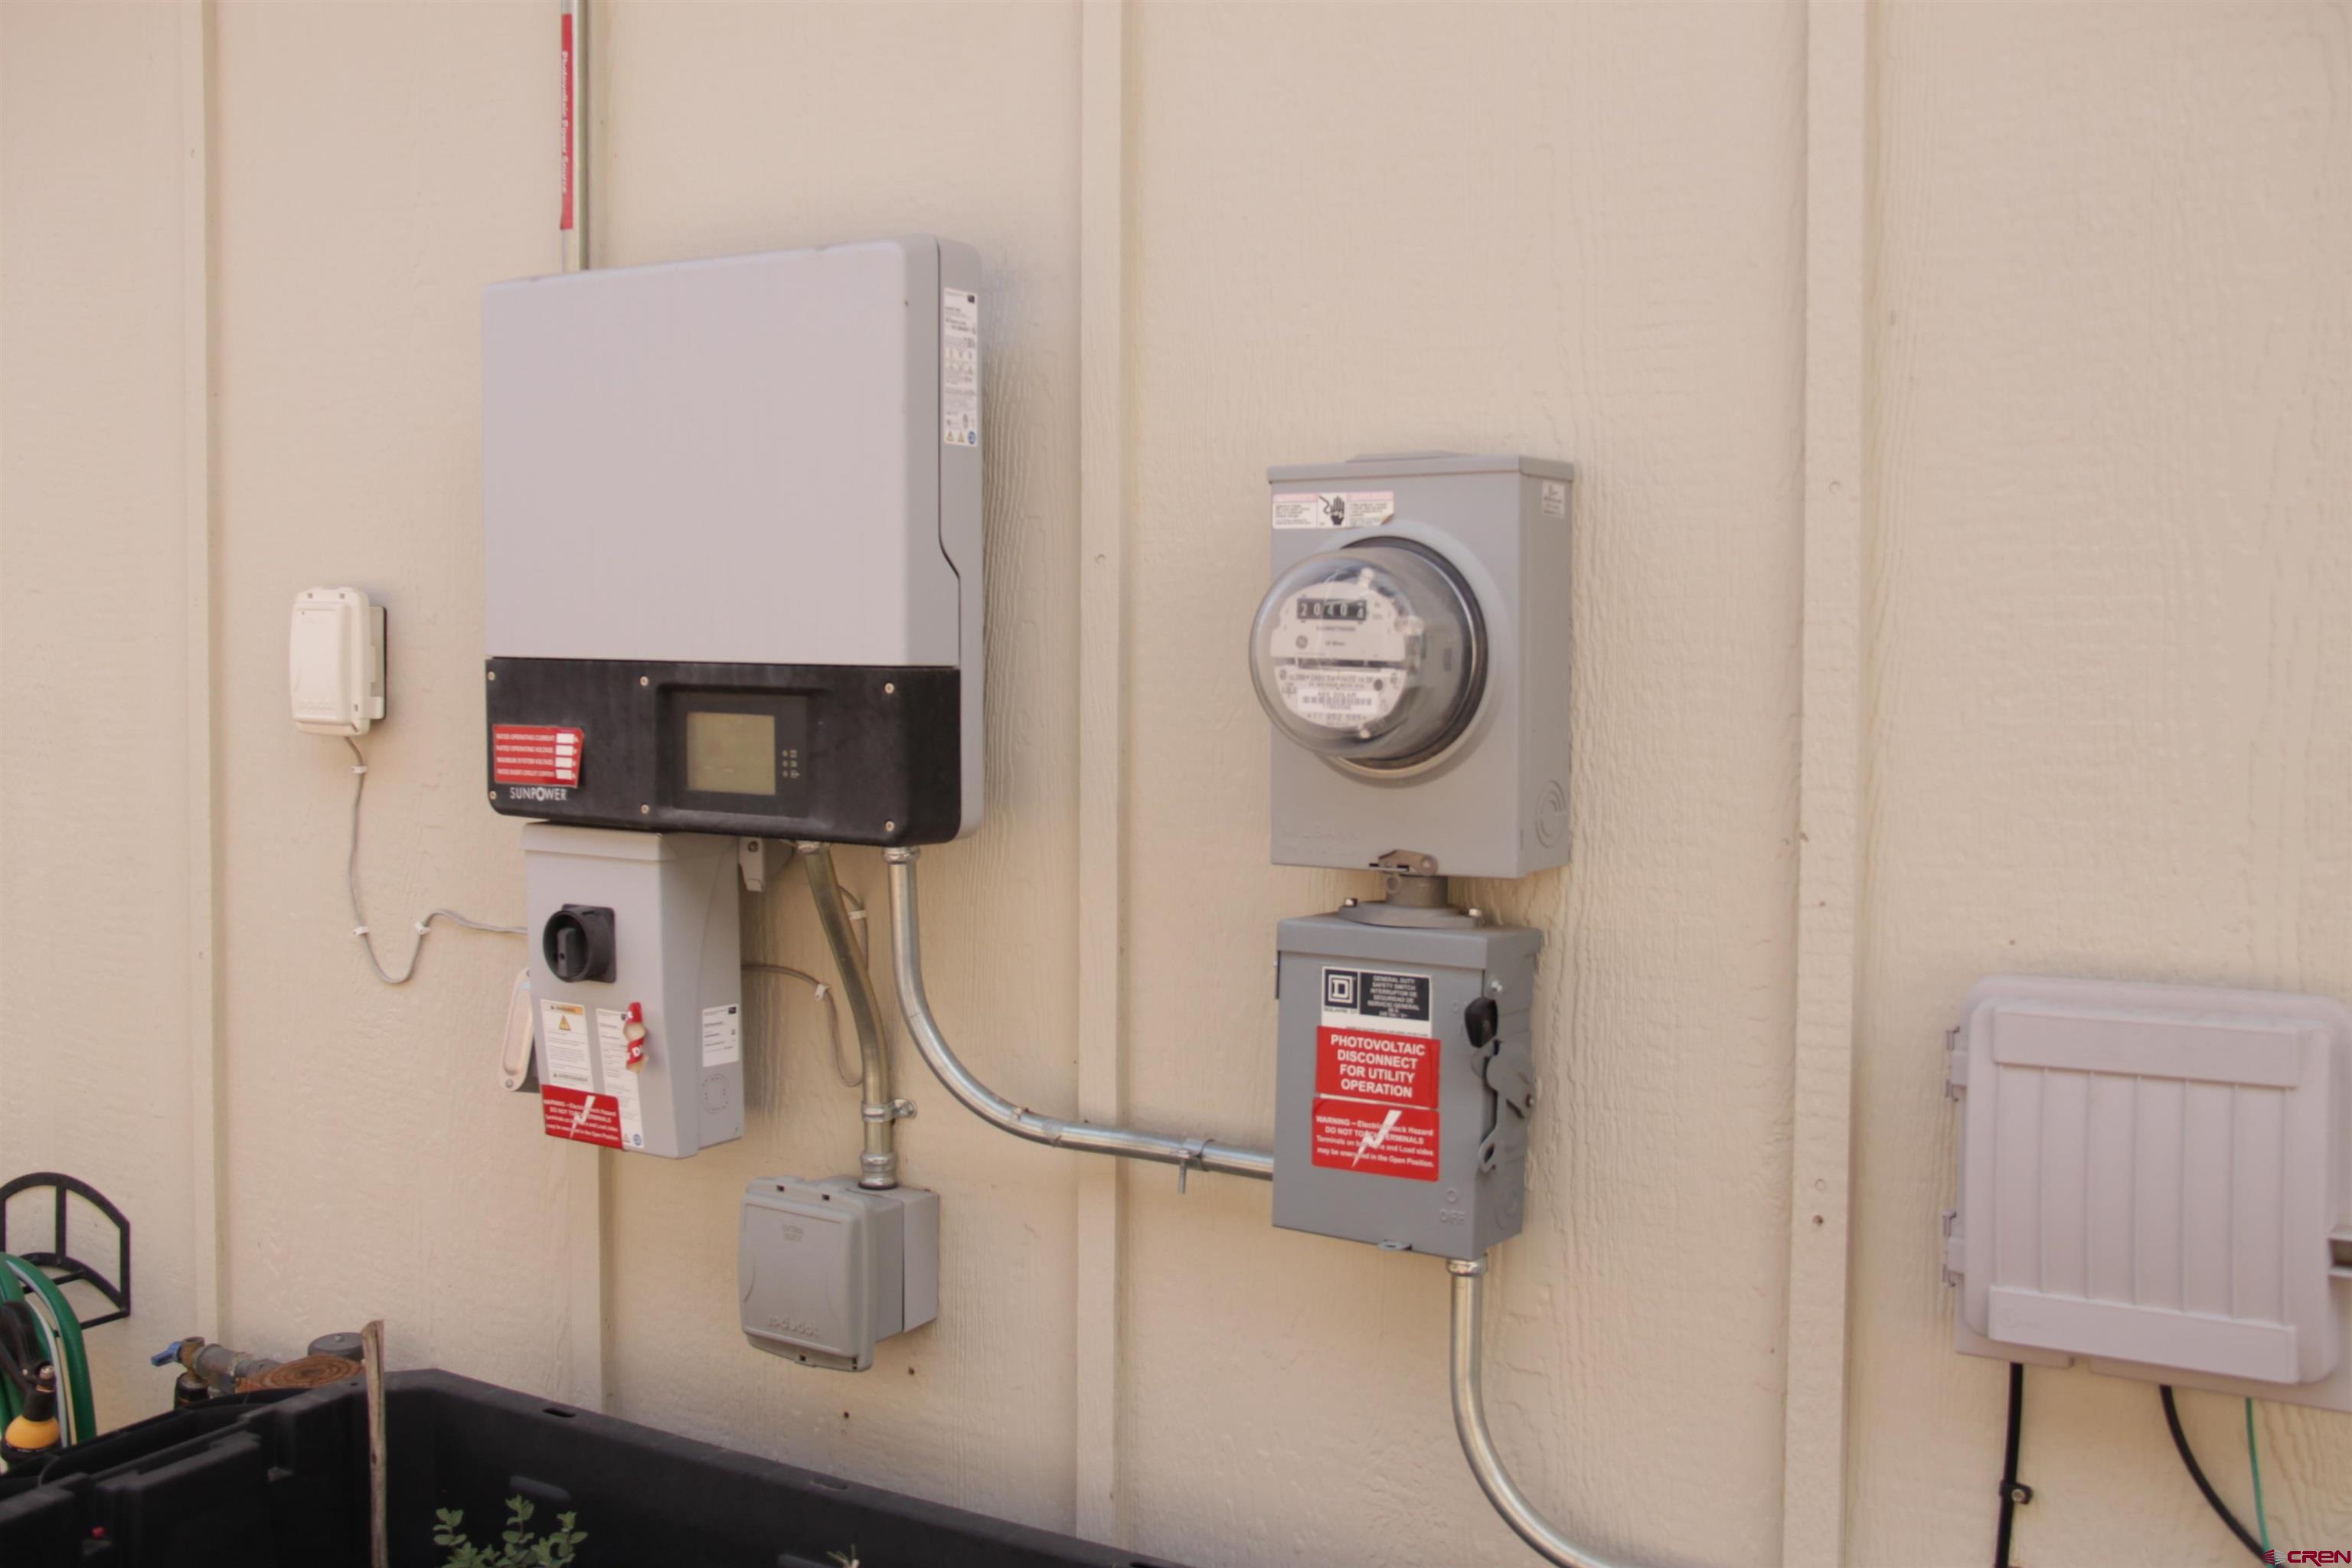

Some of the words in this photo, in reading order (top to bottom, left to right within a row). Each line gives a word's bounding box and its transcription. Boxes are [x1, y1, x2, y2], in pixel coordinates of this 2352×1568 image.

[509, 787, 568, 802] SUNPOWER
[1331, 1034, 1426, 1056] PHOTOVOLTAIC
[1337, 1049, 1419, 1070] DISCONNECT
[1340, 1064, 1366, 1077] FOR
[1368, 1067, 1416, 1083] UTILITY
[1341, 1078, 1413, 1099] OPERATION
[1315, 1115, 1351, 1126] WARNING
[1407, 1126, 1434, 1137] Hazard
[1325, 1125, 1337, 1134] DO
[1337, 1127, 1353, 1136] NOT
[1315, 1135, 1346, 1145] Terminals
[1386, 1144, 1399, 1152] and
[1399, 1145, 1416, 1155] Load
[1416, 1148, 1434, 1157] sides
[1316, 1147, 1330, 1155] may
[1377, 1153, 1388, 1162] the
[1388, 1155, 1406, 1165] Open
